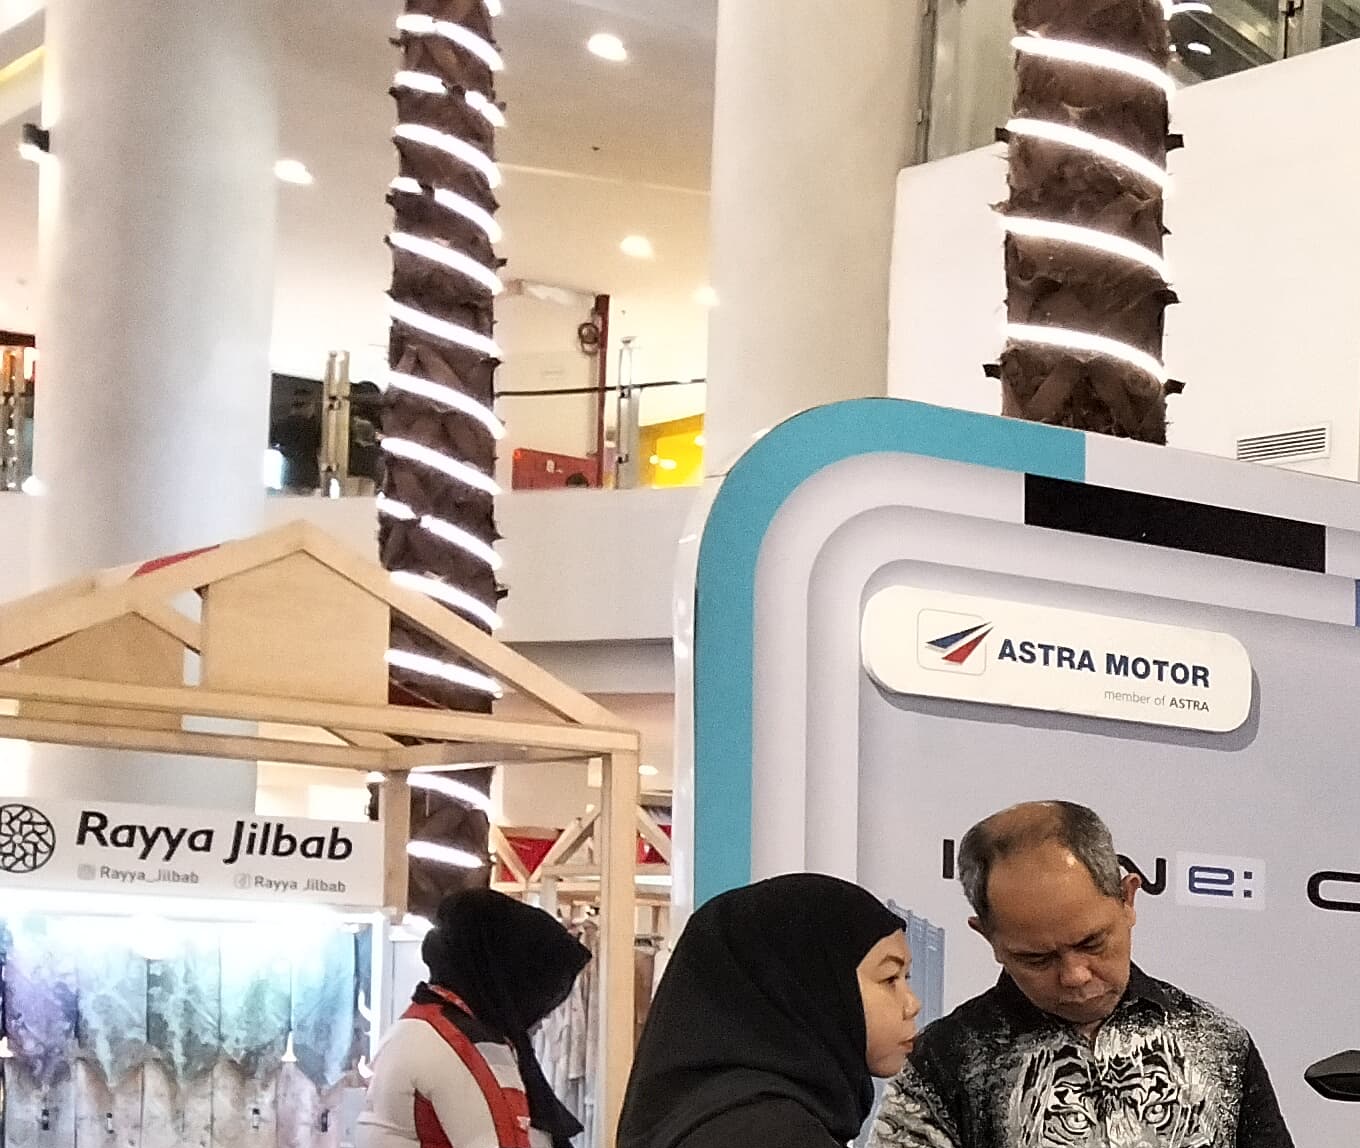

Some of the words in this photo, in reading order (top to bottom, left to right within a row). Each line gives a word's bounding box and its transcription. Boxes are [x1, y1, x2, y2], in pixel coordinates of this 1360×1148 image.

[998, 638, 1095, 672] ASTRA
[1106, 653, 1210, 687] MOTOR
[1104, 691, 1151, 704] member
[1154, 696, 1165, 706] of
[1169, 697, 1210, 712] ASTRA
[76, 810, 215, 862] Rayya
[223, 820, 354, 865] Jilbab
[254, 875, 298, 891] Rayya
[303, 879, 347, 893] Jilbab
